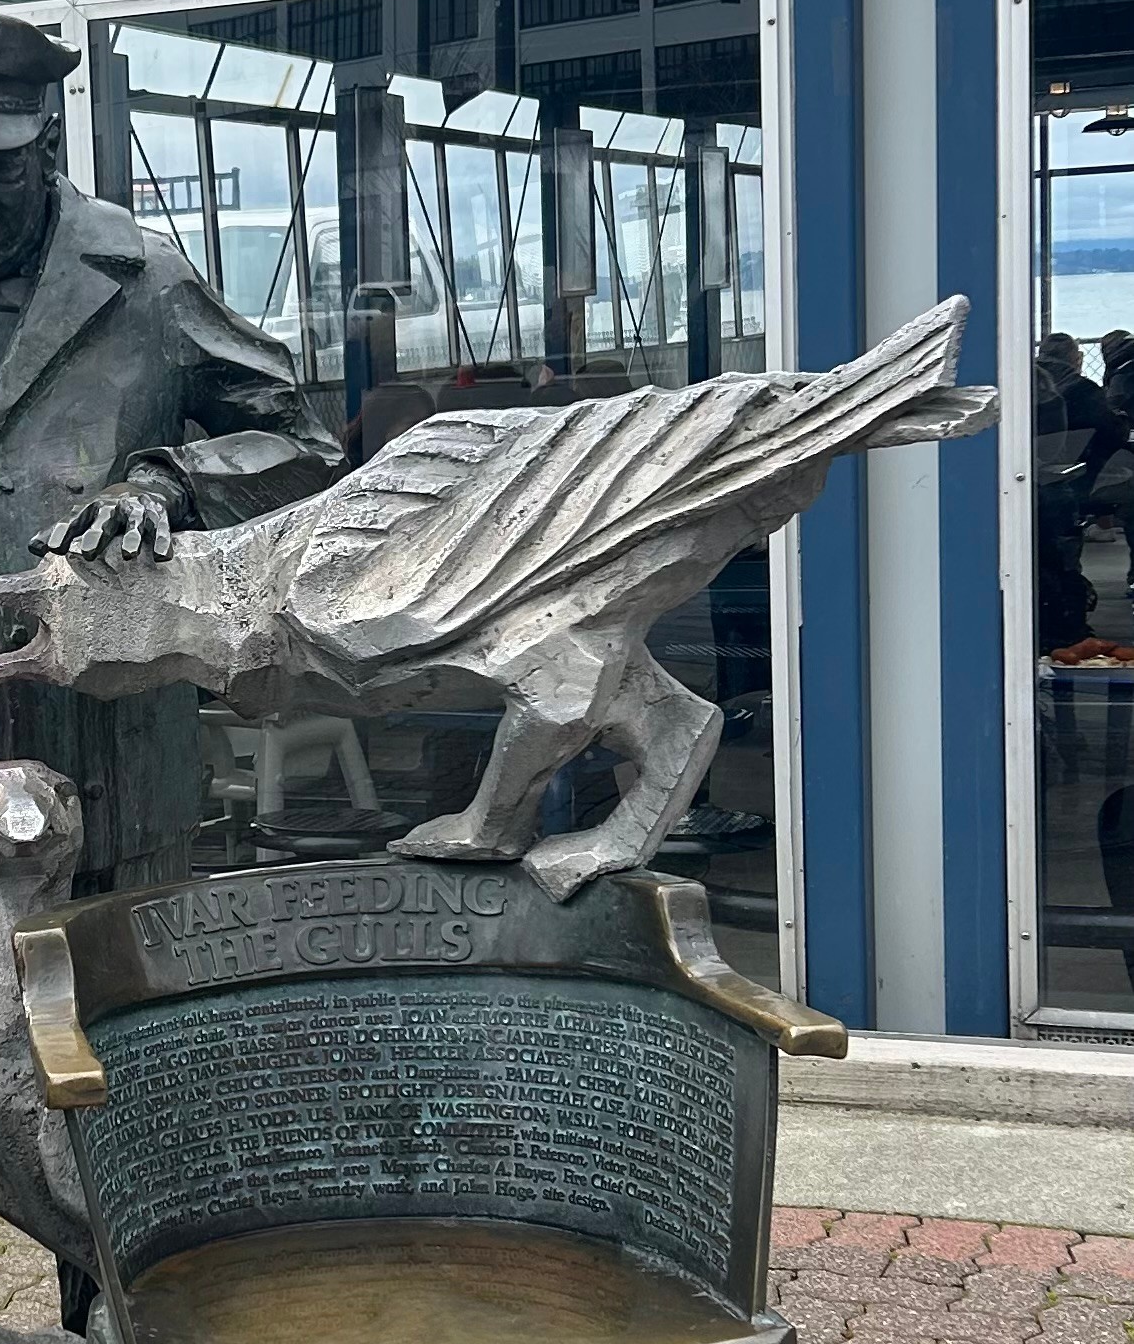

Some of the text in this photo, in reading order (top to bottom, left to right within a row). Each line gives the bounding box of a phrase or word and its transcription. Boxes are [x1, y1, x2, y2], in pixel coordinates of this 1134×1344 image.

[132, 872, 509, 947] IVAR FEEDING
[174, 917, 474, 986] THE GULLS
[120, 1017, 179, 1044] waterfront
[179, 1008, 209, 1029] folk
[245, 995, 330, 1017] contributed,
[332, 994, 349, 1009] in
[350, 992, 396, 1012] public
[399, 991, 493, 1010] subscription,
[497, 993, 515, 1007] to
[517, 992, 540, 1008] the
[544, 995, 607, 1015] placement
[607, 1004, 622, 1019] of
[622, 1005, 642, 1024] this
[125, 1046, 141, 1061] the
[143, 1033, 189, 1057] captain's
[229, 1022, 258, 1037] The
[309, 1014, 360, 1028] donors
[365, 1013, 393, 1025] are:
[401, 1009, 448, 1026] JOAN
[451, 1010, 480, 1025] and
[480, 1009, 549, 1029] MORRIE
[628, 1025, 672, 1050] ARCTIC
[672, 1036, 708, 1065] ALASKA
[144, 1058, 163, 1076] and
[169, 1042, 234, 1067] GORDON
[284, 1030, 348, 1050] BRODIE
[642, 1048, 676, 1072] JERRY
[674, 1060, 693, 1078] and
[187, 1061, 231, 1082] DAVIS
[232, 1052, 302, 1073] WRIGHT
[304, 1051, 319, 1065] &
[390, 1045, 470, 1061] HECKLER
[580, 1055, 635, 1080] HURLEN
[636, 1066, 714, 1110] CONSTRUCTION
[188, 1104, 213, 1120] and
[217, 1095, 249, 1113] NED
[338, 1083, 437, 1100] SPOTLIGHT
[631, 1104, 651, 1124] JAY
[216, 1074, 274, 1095] CHUCK
[277, 1065, 365, 1087] PETERSON
[370, 1064, 400, 1080] and
[404, 1064, 480, 1084] Daughters
[505, 1067, 572, 1088] PAMELA,
[227, 1117, 245, 1135] H.
[306, 1106, 338, 1122] U.S.
[343, 1103, 393, 1121] BANK
[398, 1102, 423, 1118] OF
[616, 1120, 657, 1146] HOTEL
[658, 1137, 675, 1153] and
[227, 1134, 260, 1153] THE
[263, 1126, 333, 1146] FRIENDS
[336, 1124, 359, 1140] OF
[363, 1122, 407, 1138] IVAR
[409, 1122, 519, 1141] COMMITTEE,
[520, 1126, 551, 1143] who
[552, 1129, 602, 1152] initiated
[602, 1141, 624, 1155] and
[237, 1151, 274, 1171] John
[331, 1140, 396, 1158] Kenneth
[455, 1139, 510, 1156] Charles
[512, 1142, 528, 1158] E.
[591, 1153, 627, 1176] Victor
[187, 1205, 204, 1225] by
[206, 1194, 256, 1217] Charles
[307, 1179, 365, 1199] foundry
[420, 1178, 449, 1193] and
[452, 1177, 490, 1196] John
[541, 1187, 566, 1203] site
[196, 1183, 218, 1199] and
[246, 1173, 269, 1188] the
[273, 1166, 337, 1186] sculpture
[342, 1164, 370, 1176] are:
[380, 1158, 430, 1178] Mayor
[433, 1158, 491, 1174] Charles
[494, 1160, 512, 1177] A.
[562, 1168, 588, 1186] Fire
[591, 1173, 625, 1194] Chief
[626, 1181, 660, 1207] Claude
[644, 1209, 684, 1242] Dedicated
